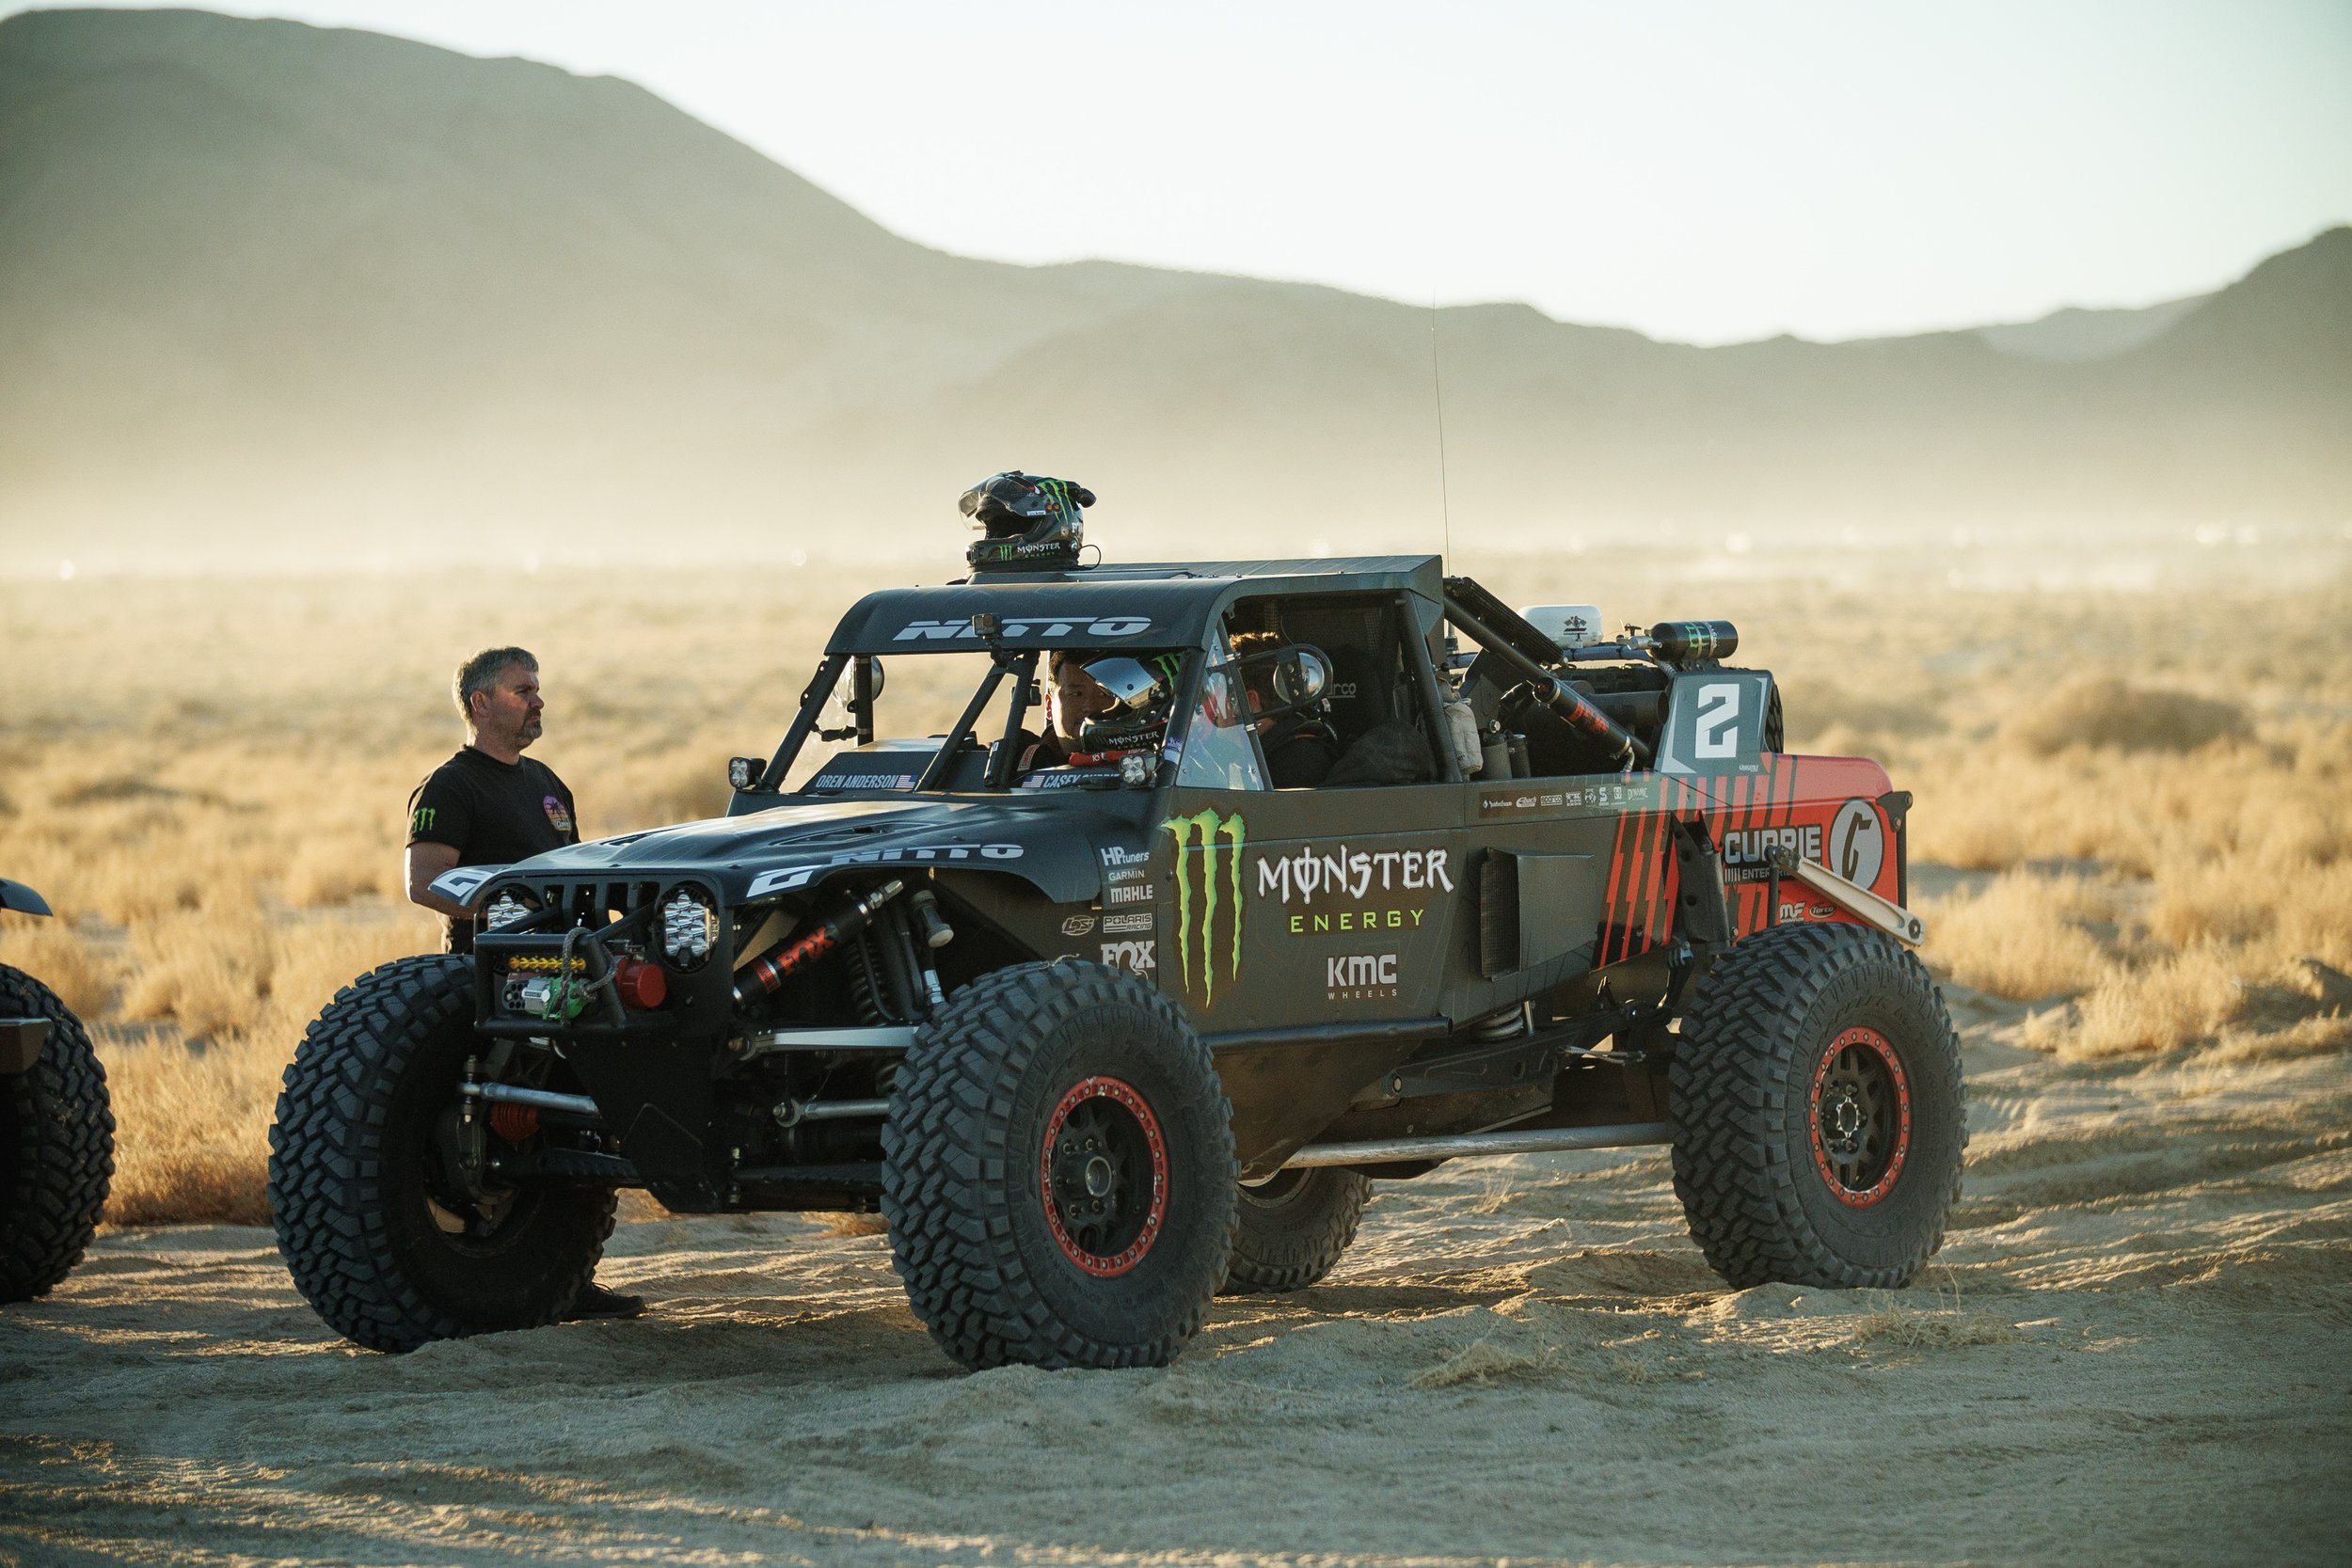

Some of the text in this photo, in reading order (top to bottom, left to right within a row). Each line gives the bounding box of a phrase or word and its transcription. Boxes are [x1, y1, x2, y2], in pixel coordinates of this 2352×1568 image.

[1017, 542, 1060, 554] MONSTER
[1695, 684, 1739, 758] 2
[1108, 731, 1159, 745] MONSTER
[816, 775, 899, 788] OREN ANDERSON
[832, 844, 1024, 864] NITTO
[1108, 870, 1145, 881] GARMIN
[1257, 844, 1454, 904] MONSTER
[1110, 884, 1153, 903] MAHLE
[1104, 913, 1152, 925] POLARIS
[1290, 909, 1424, 933] ENERGY
[1101, 941, 1156, 974] FOX
[1327, 955, 1397, 987] KMC
[1327, 989, 1397, 1001] WHEELS
